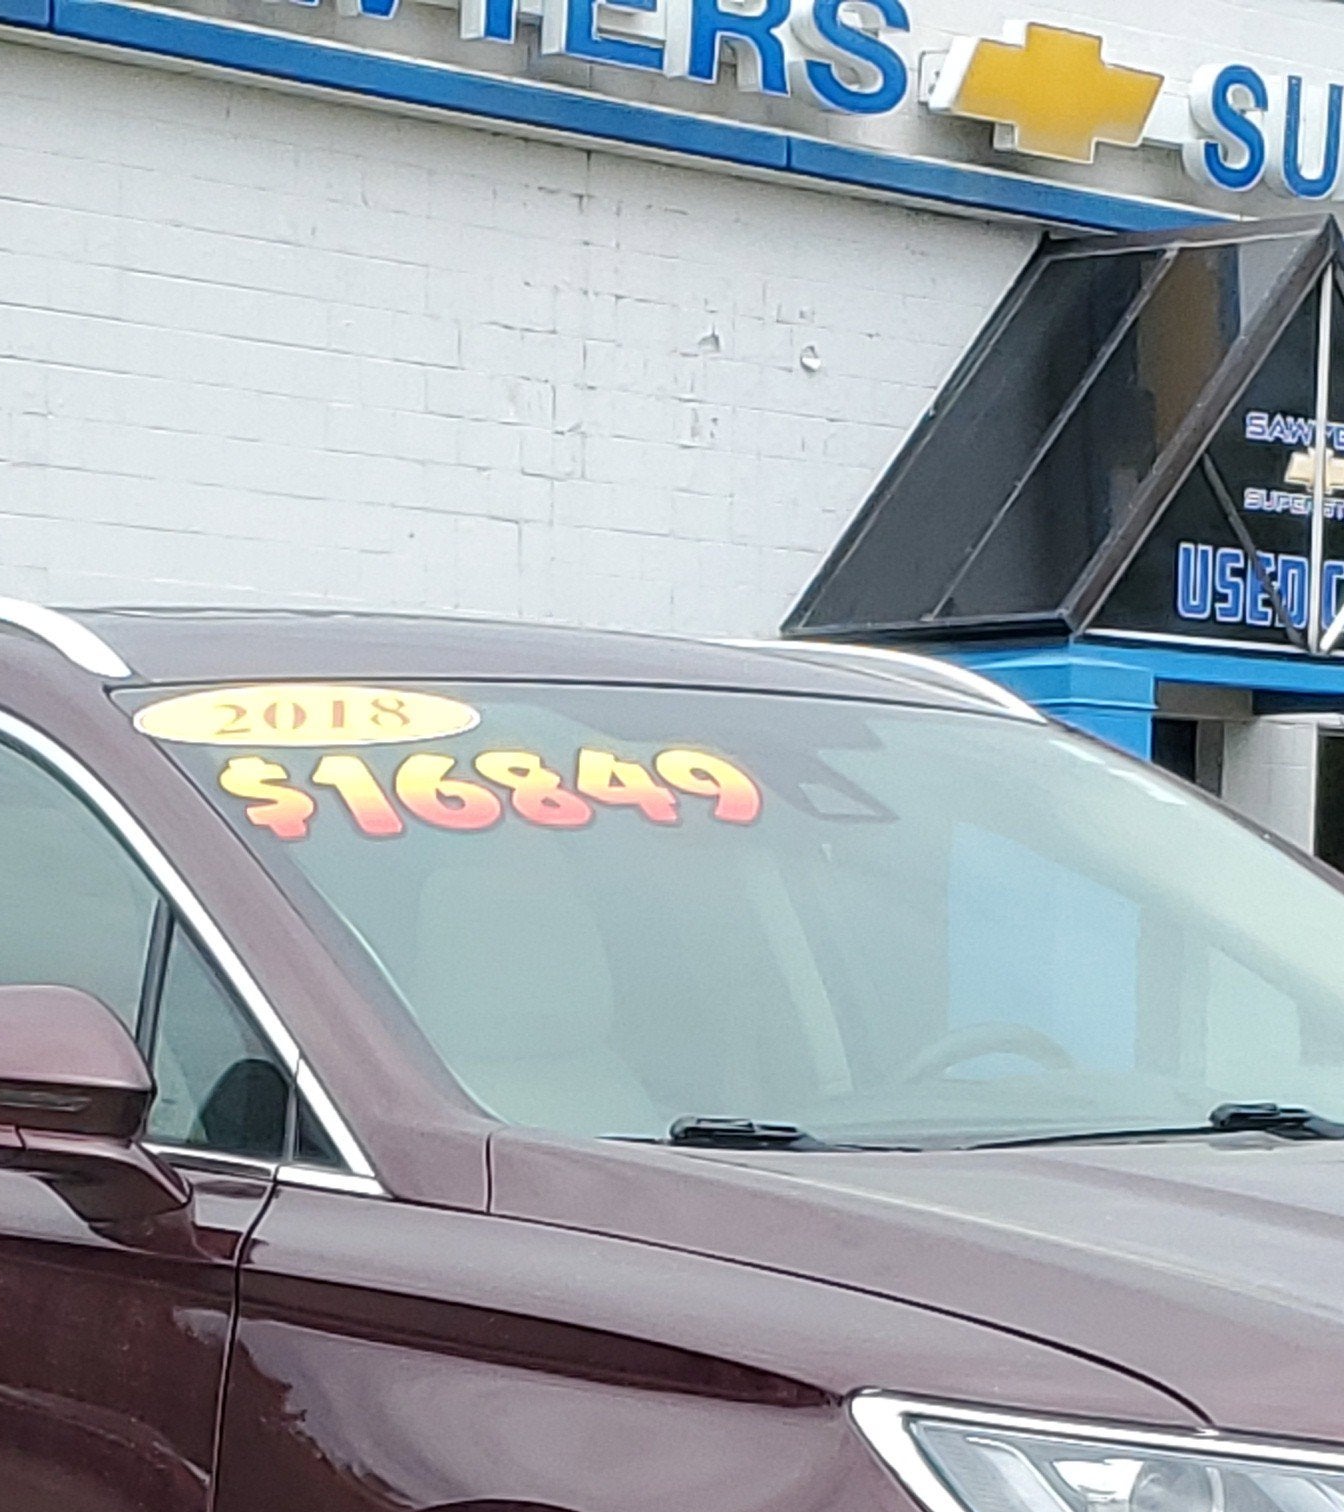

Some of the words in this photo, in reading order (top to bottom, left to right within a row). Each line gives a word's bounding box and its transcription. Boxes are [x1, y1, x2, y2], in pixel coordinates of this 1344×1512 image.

[1177, 542, 1309, 630] USED
[214, 698, 411, 735] 2018
[218, 747, 761, 842] $16849
